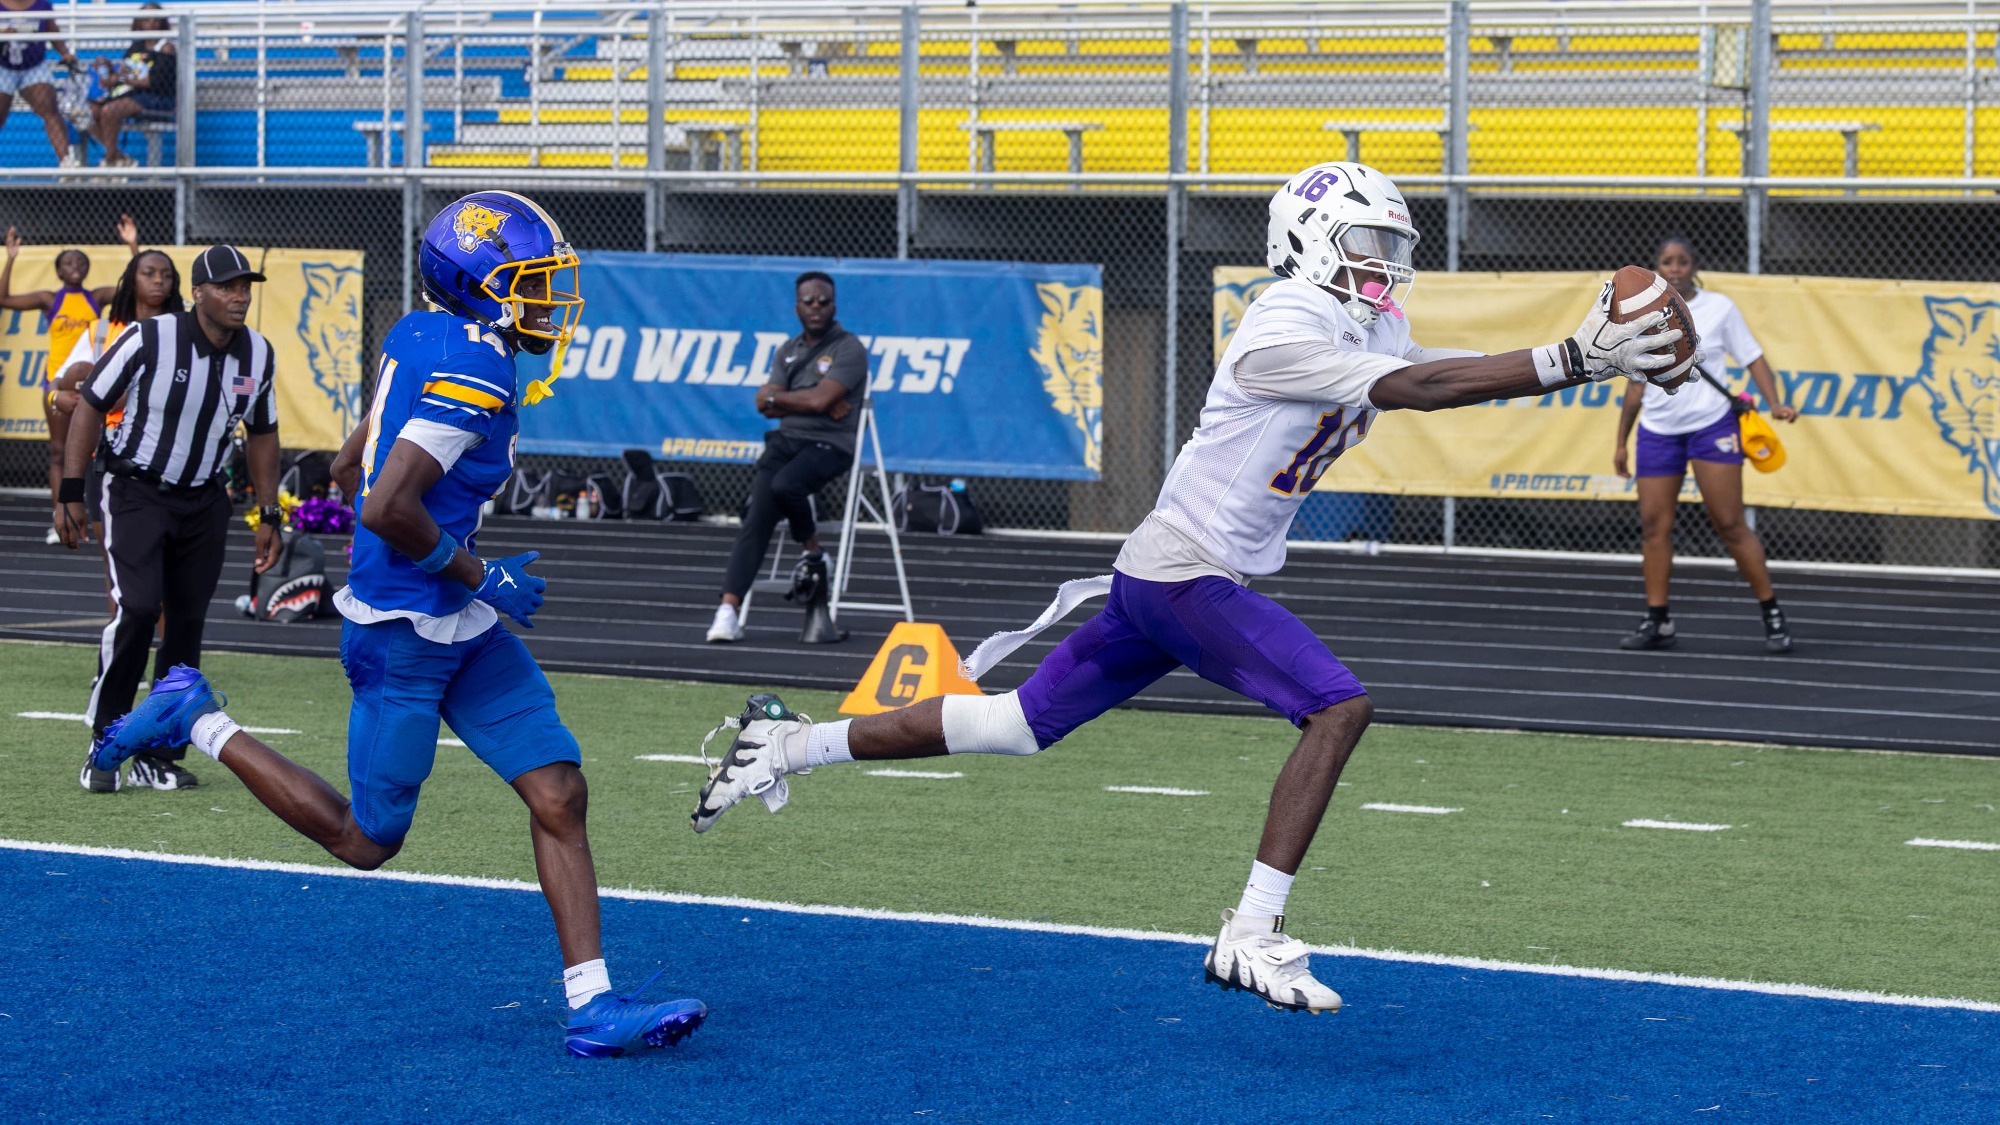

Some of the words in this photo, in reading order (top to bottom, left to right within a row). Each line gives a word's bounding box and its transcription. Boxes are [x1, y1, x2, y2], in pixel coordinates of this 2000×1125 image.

[1294, 170, 1338, 202] 16
[463, 323, 507, 358] 14
[633, 328, 972, 394] WILDTS!
[175, 369, 188, 383] S
[1268, 405, 1370, 497] 16
[875, 643, 929, 707] G
